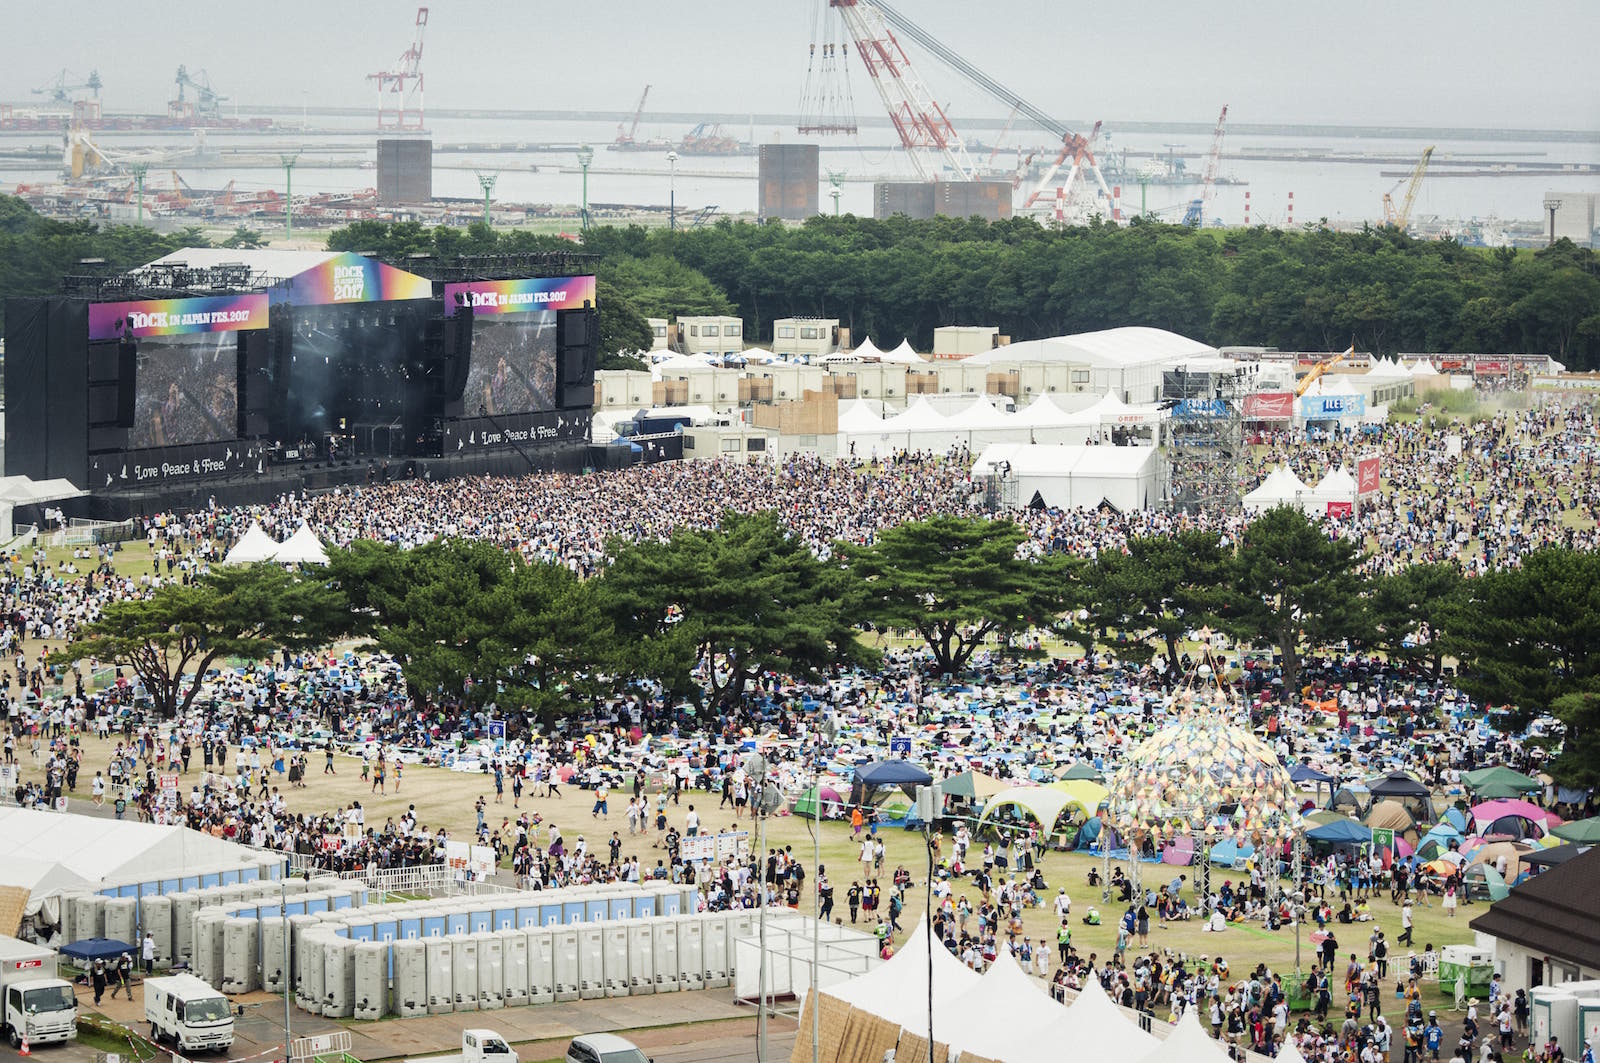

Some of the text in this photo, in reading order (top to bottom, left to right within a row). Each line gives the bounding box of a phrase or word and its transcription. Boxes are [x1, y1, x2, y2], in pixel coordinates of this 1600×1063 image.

[334, 265, 364, 278] ROCK
[334, 283, 364, 300] 2017
[499, 294, 508, 305] IN
[509, 292, 533, 304] JAPAN
[169, 315, 181, 326] IN
[182, 312, 210, 325] JAPAN
[481, 426, 558, 445] Love Peace & Free.
[134, 458, 226, 480] Love Peace & Free.
